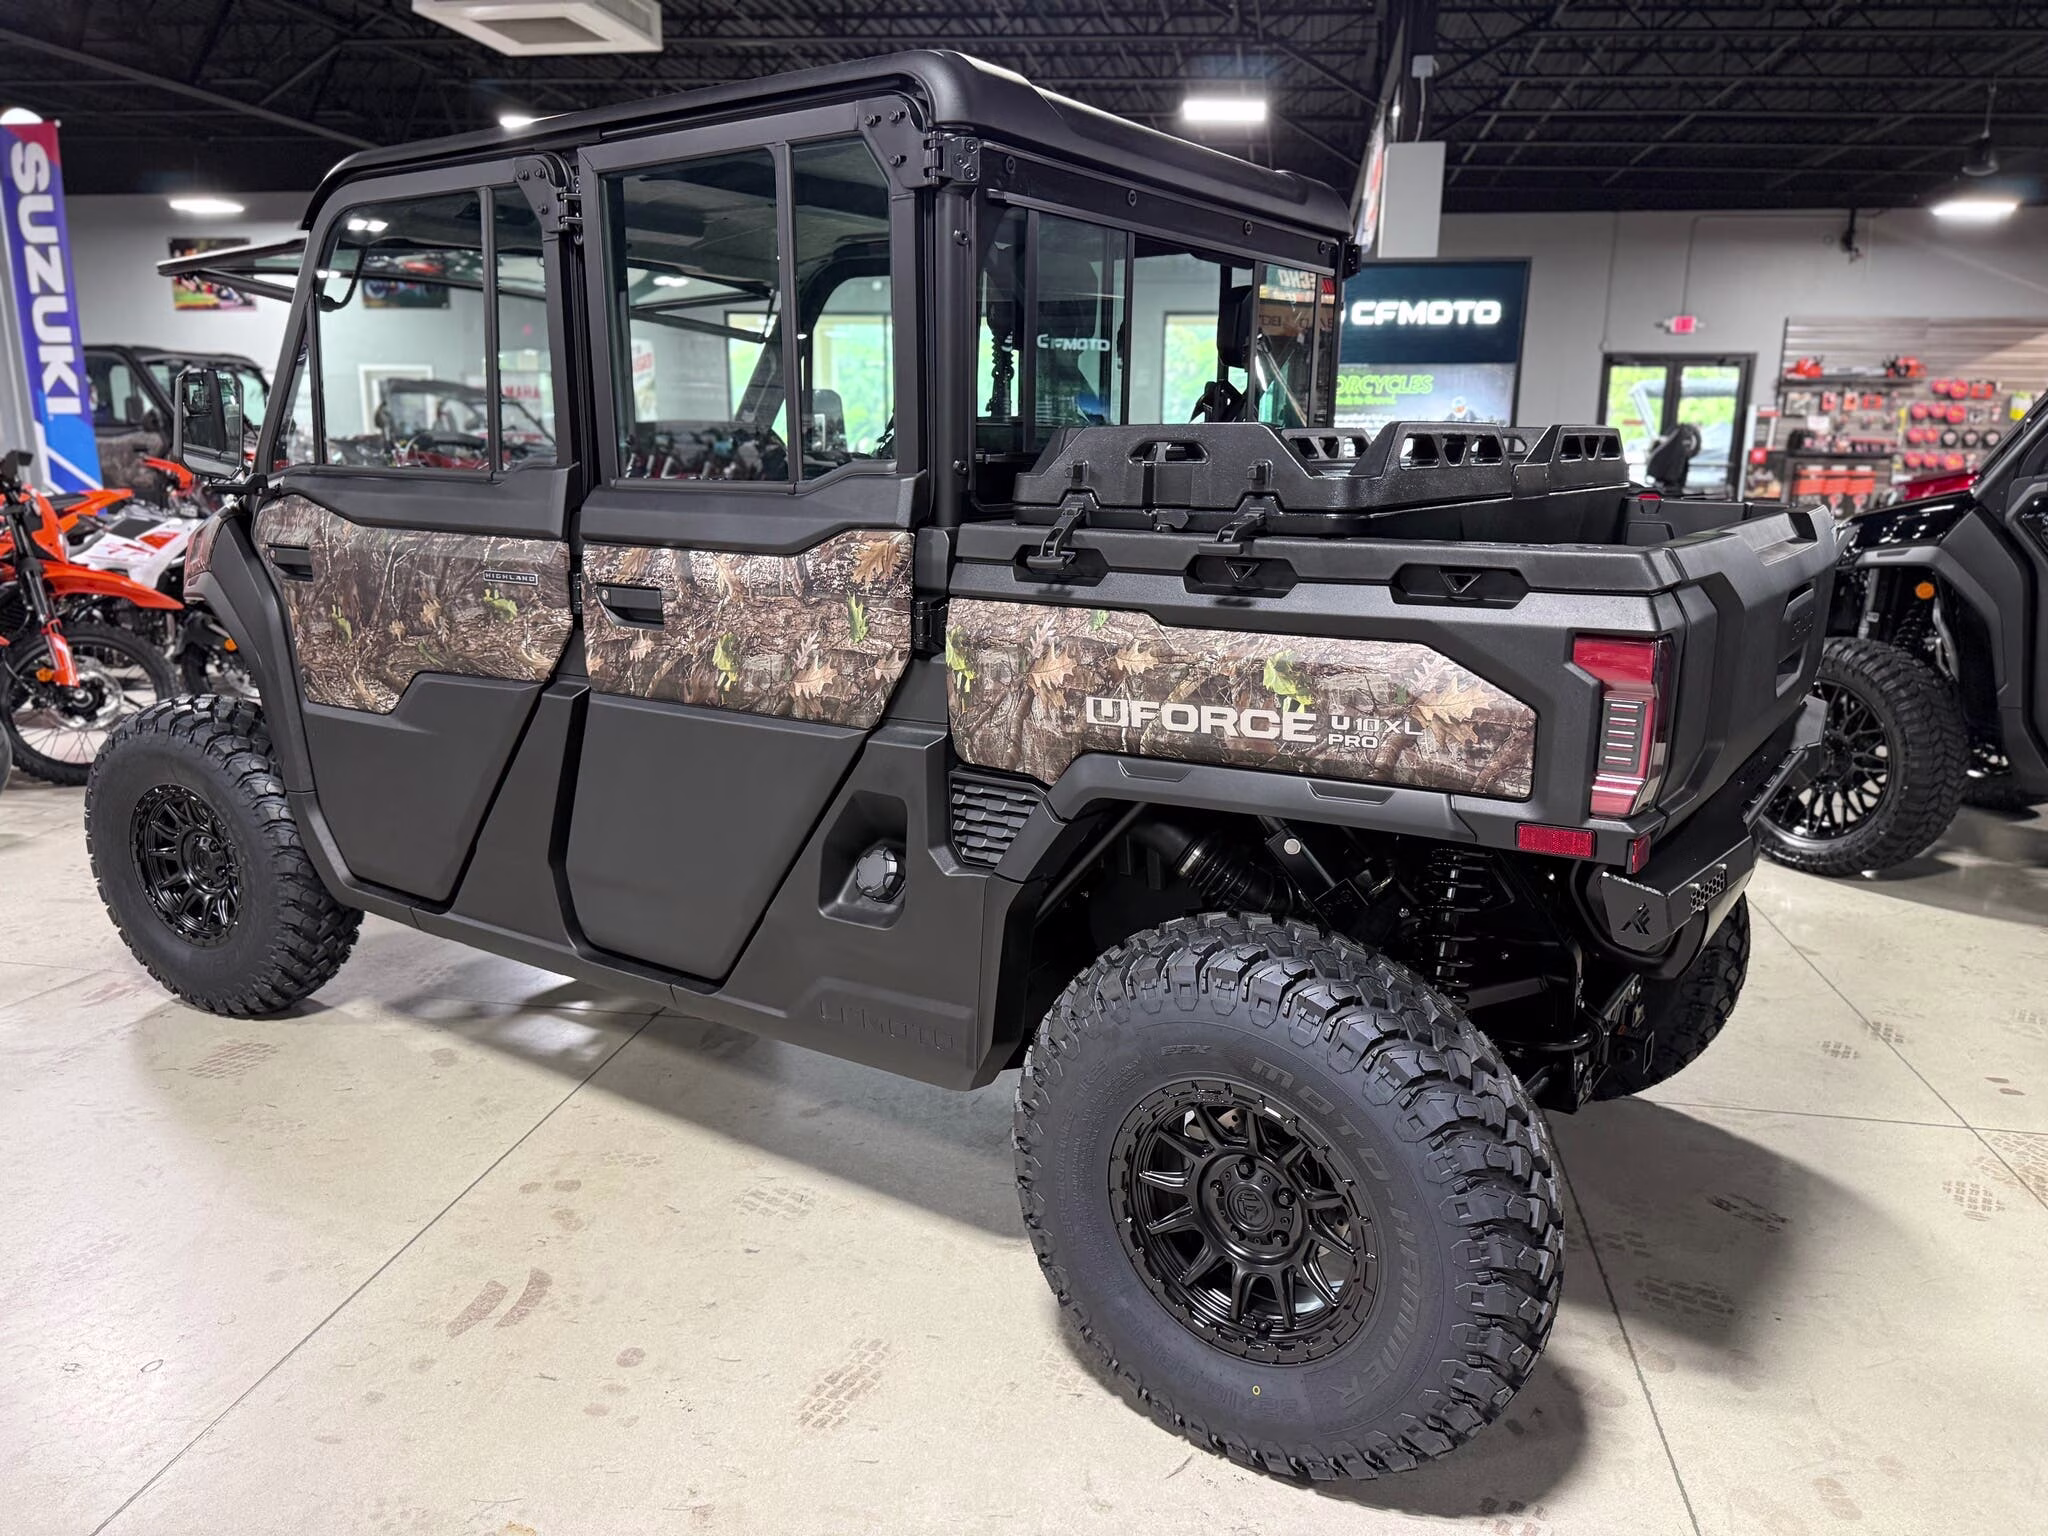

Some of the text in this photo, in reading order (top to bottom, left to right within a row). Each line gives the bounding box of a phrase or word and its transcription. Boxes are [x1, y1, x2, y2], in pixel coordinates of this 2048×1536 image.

[10, 141, 82, 415] SUZUKI
[1351, 299, 1502, 326] CFMOTO
[1337, 374, 1434, 395] ORCYCLES
[485, 572, 536, 582] HIGHLAND
[1328, 733, 1379, 749] PRO
